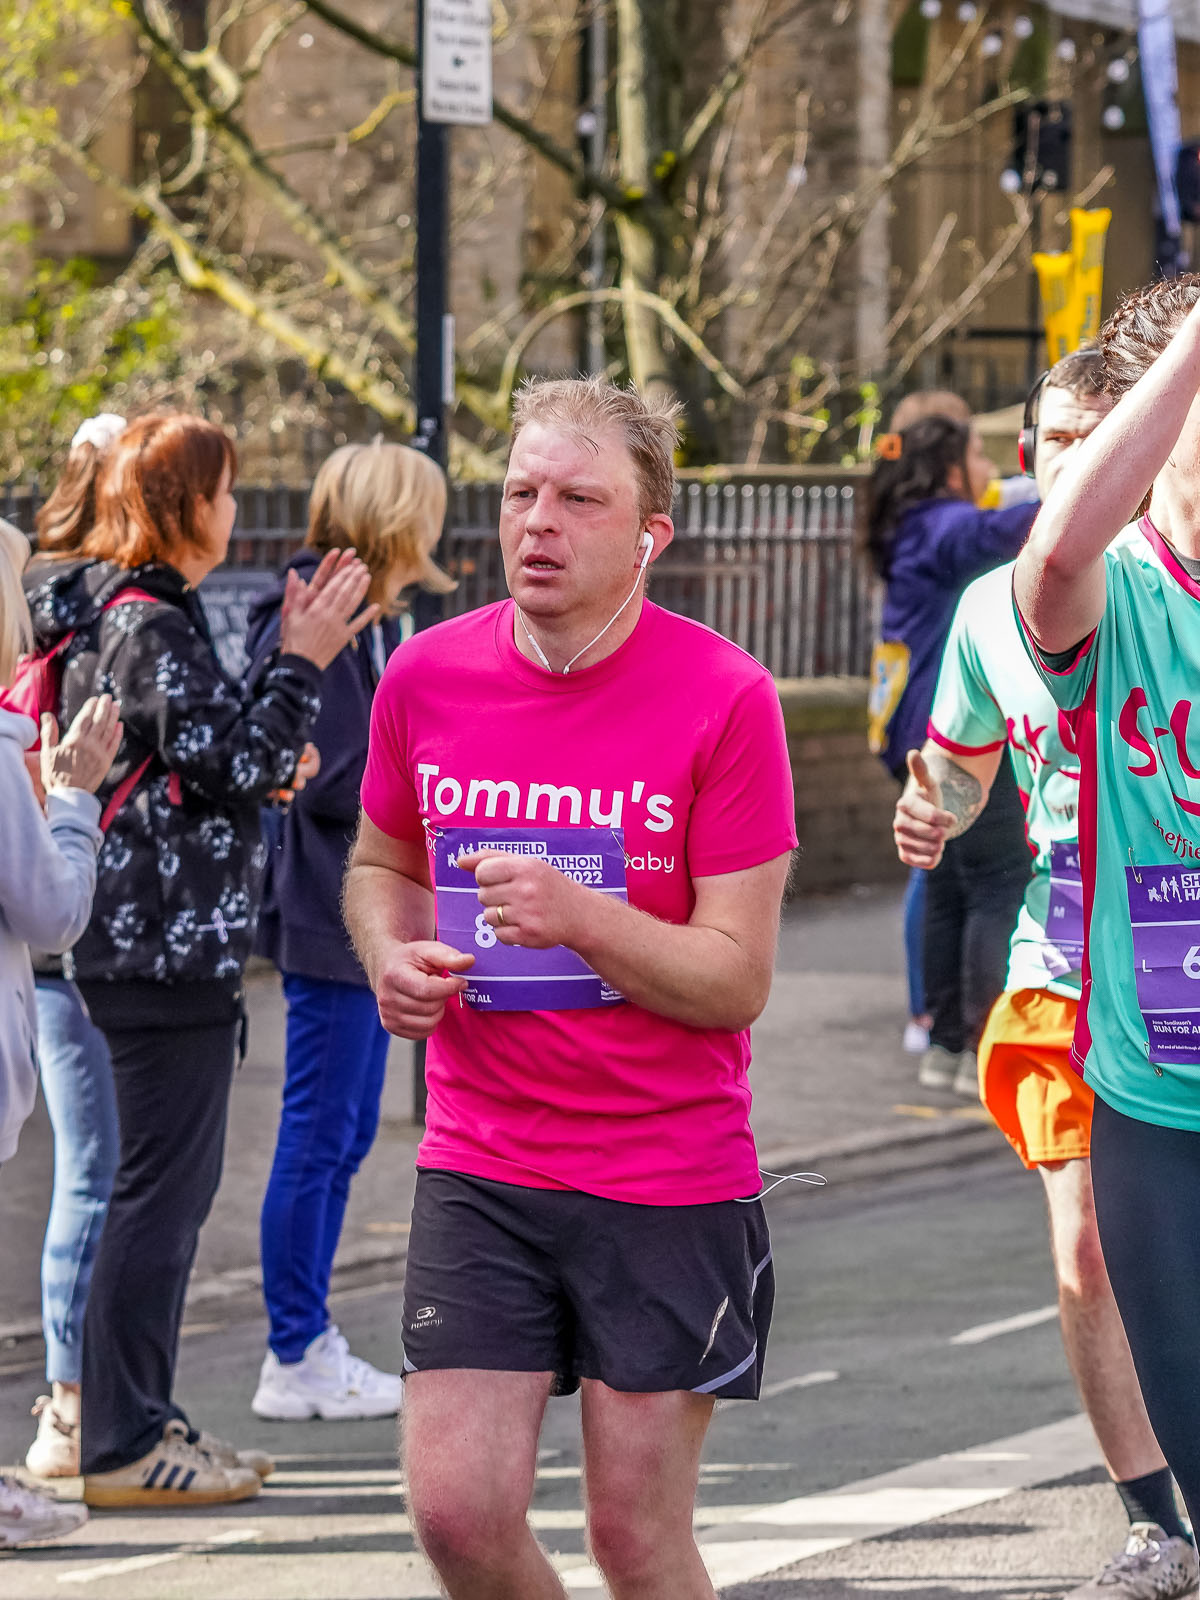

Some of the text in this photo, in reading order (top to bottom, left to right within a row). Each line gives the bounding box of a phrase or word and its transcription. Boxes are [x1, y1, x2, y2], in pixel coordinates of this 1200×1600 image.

[417, 763, 674, 833] Tommy's
[1053, 905, 1065, 918] M
[1142, 959, 1153, 973] L
[477, 994, 493, 1003] ALL
[1153, 1025, 1171, 1034] RUN
[1172, 1025, 1190, 1034] FOR
